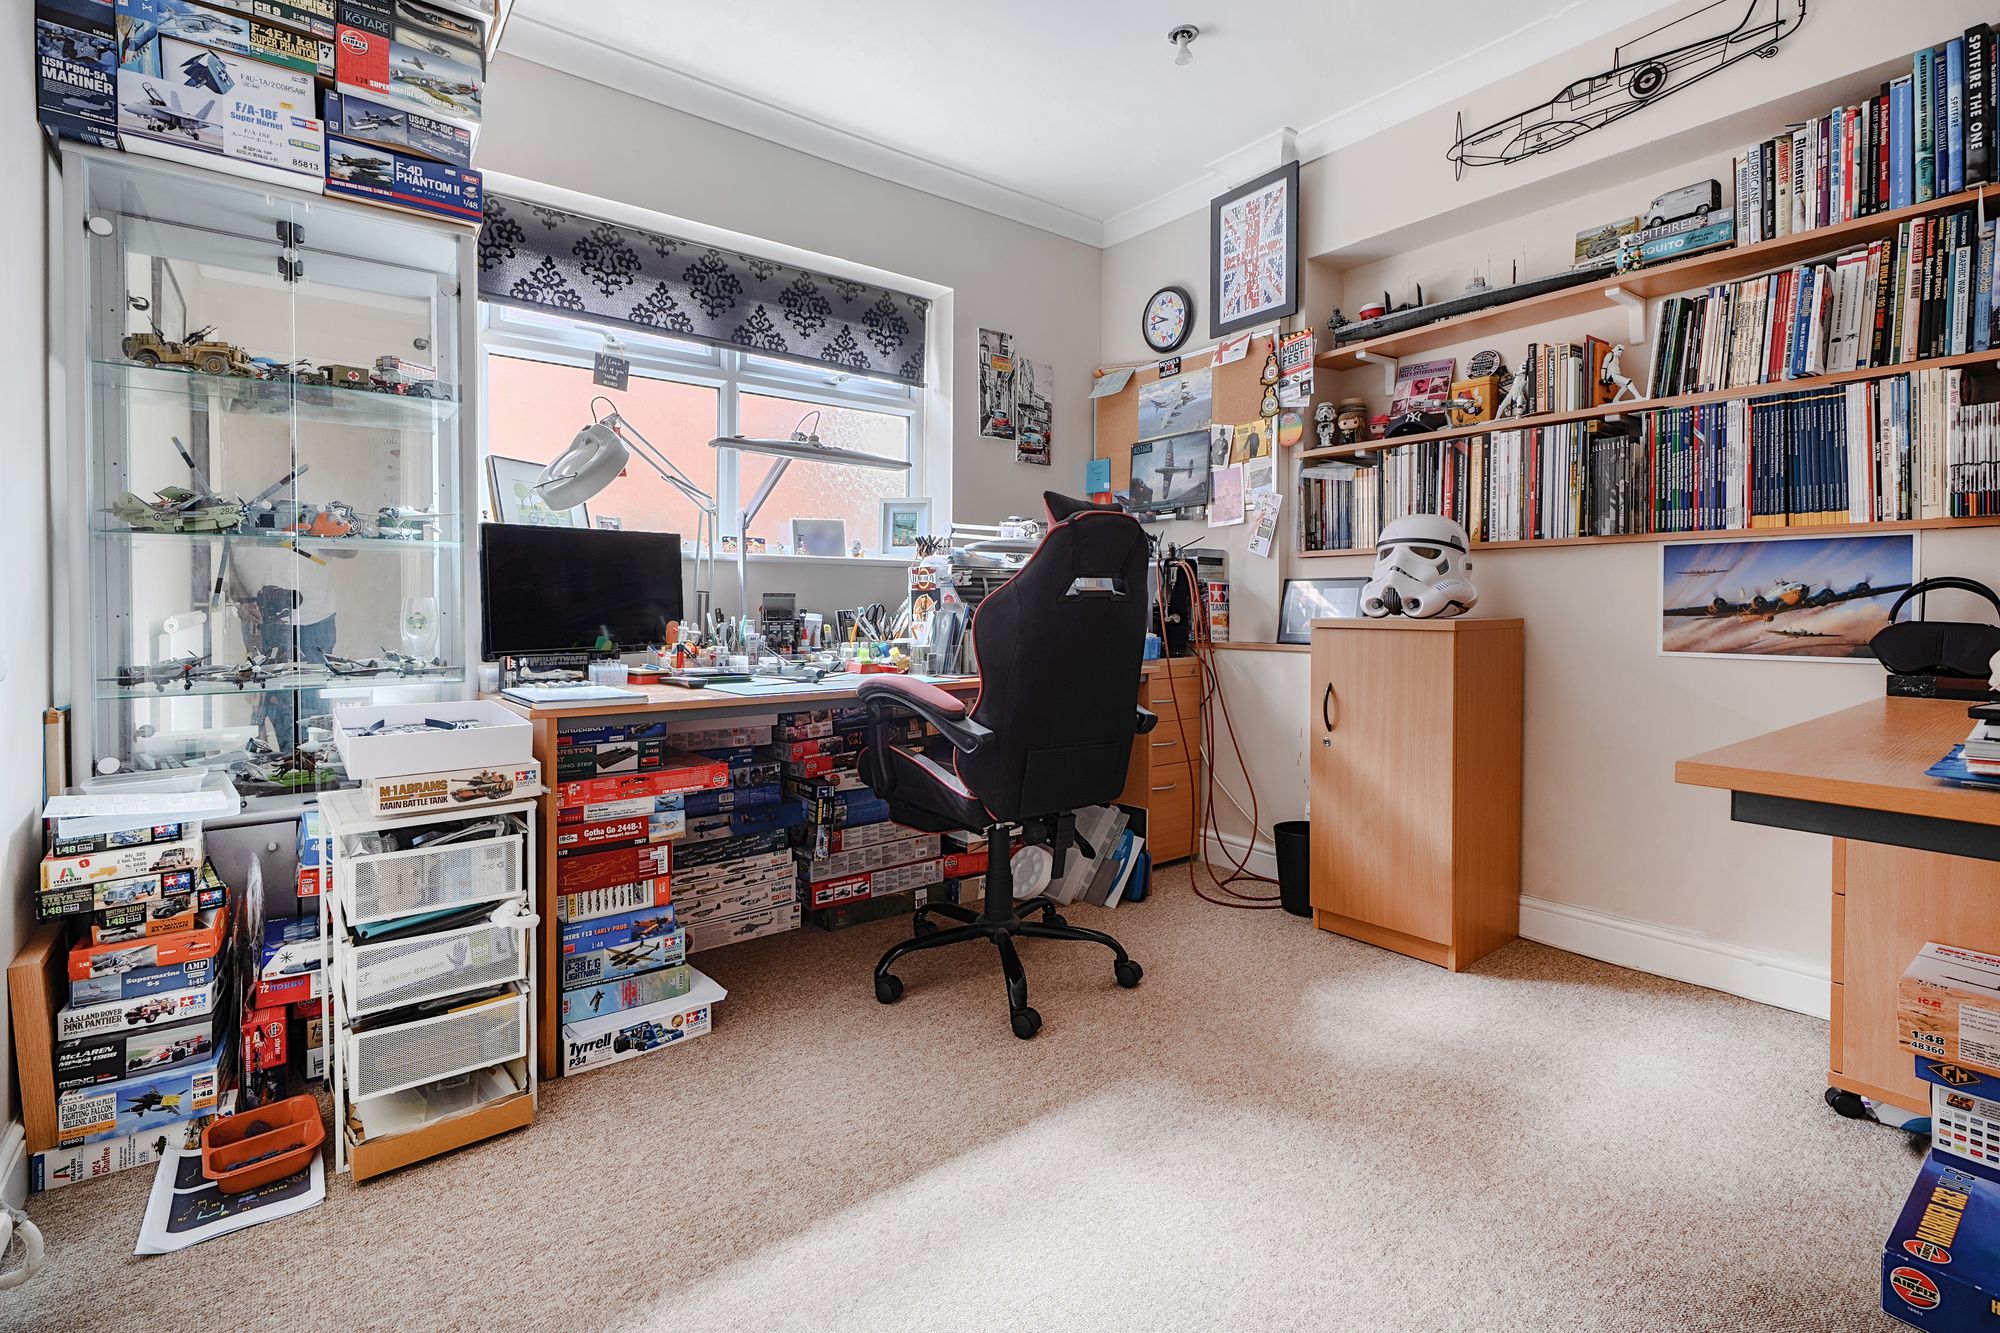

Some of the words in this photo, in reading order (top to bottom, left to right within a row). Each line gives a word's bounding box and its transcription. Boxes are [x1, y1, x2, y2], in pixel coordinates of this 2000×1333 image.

[251, 34, 277, 50] SUPER
[280, 41, 318, 60] PHANTOM
[342, 37, 367, 49] AIRFIX
[42, 56, 63, 70] USN
[66, 62, 107, 81] PBM-5A
[1969, 35, 1982, 89] SPITFIRE
[42, 65, 114, 95] MARINER
[235, 101, 278, 121] F/A-18F
[1950, 96, 1959, 128] SPITFIRE
[1970, 92, 1982, 117] THE
[230, 111, 255, 125] Super
[256, 118, 283, 130] Hornet
[408, 114, 429, 129] USAF
[431, 120, 453, 135] A-10C
[1969, 122, 1982, 150] ONE
[292, 159, 319, 170] 85813
[396, 161, 422, 177] F-4D
[1794, 137, 1806, 195] Alarmstart
[396, 172, 449, 193] PHANTOM
[450, 186, 460, 196] II
[1750, 150, 1759, 205] HURRICANE
[463, 199, 478, 209] 1/48
[1635, 219, 1692, 241] SPITFIRE!
[1914, 225, 1924, 248] CLASSIC
[1926, 219, 1935, 256] Thunderbolt
[1881, 241, 1890, 263] FOCKE
[1924, 258, 1933, 274] Roger
[1880, 265, 1889, 285] WULF
[1923, 275, 1932, 300] Freeman
[1958, 280, 1966, 294] WAR
[1283, 340, 1309, 356] MODEL
[1283, 350, 1304, 366] FEST
[379, 784, 398, 798] M-1
[399, 779, 448, 796] ABRAMS
[380, 801, 401, 811] MAIN
[402, 798, 429, 808] BATTLE
[429, 796, 448, 805] TANK
[584, 828, 605, 838] Gotha
[606, 826, 616, 834] Go
[617, 823, 643, 832] 244B-1
[56, 845, 76, 854] 1/48
[42, 906, 62, 916] 1/48
[106, 917, 126, 927] 1/48
[594, 927, 611, 935] EARLY
[187, 960, 206, 970] AMP
[125, 970, 180, 985] Supermarine
[565, 969, 601, 982] LIGHTNING
[82, 1012, 99, 1022] LAND
[100, 1008, 123, 1018] ROVER
[64, 1022, 84, 1033] PINK
[85, 1015, 122, 1030] PANTHER
[569, 1032, 612, 1058] Tyrrell
[1912, 1030, 1945, 1046] 1:48
[60, 1046, 114, 1061] McLAREN
[1911, 1041, 1945, 1056] 48360
[569, 1055, 587, 1068] P34
[192, 1090, 214, 1100] 1:48
[61, 1104, 78, 1114] F-16D
[62, 1110, 90, 1122] FIGHTING
[90, 1104, 113, 1116] FALCON
[63, 1118, 87, 1129] HELLENIC
[98, 1112, 114, 1122] FORCE
[93, 1160, 101, 1176] M24
[101, 1147, 111, 1173] Chaffee
[1892, 1276, 1938, 1300] AIRFIX
